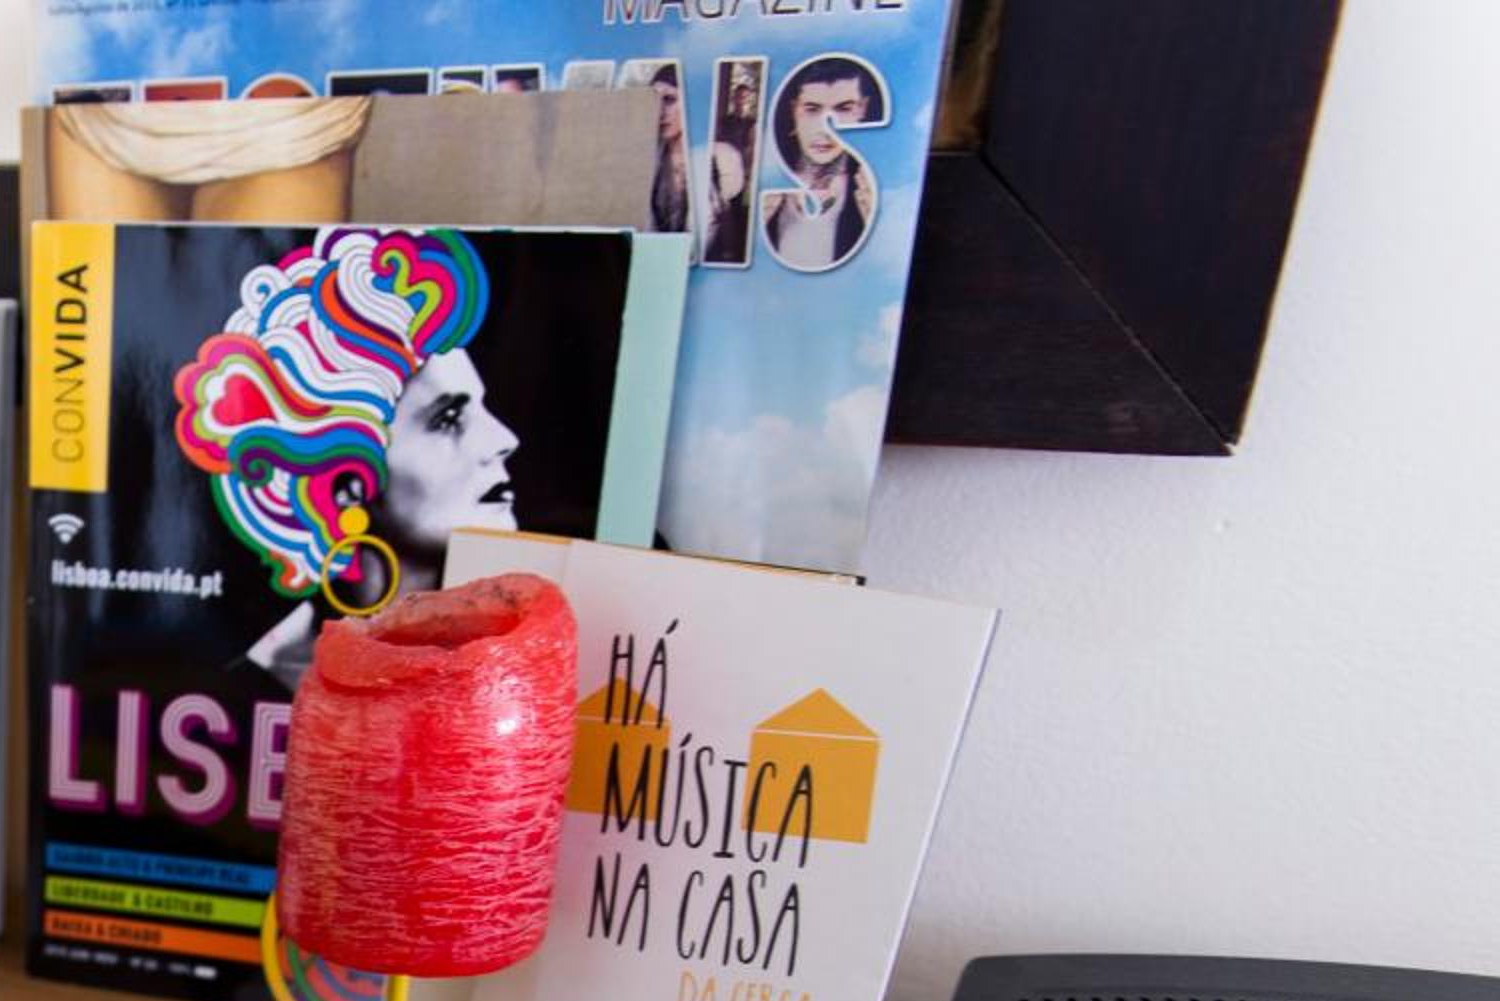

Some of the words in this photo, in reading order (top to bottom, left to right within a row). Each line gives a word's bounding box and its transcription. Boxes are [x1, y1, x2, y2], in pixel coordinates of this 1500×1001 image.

[49, 263, 90, 464] CONVIDA
[50, 559, 224, 598] lisboa.convida.pt
[604, 617, 679, 729] HÁ
[598, 732, 815, 869] MÚSICA
[586, 852, 653, 953] NA
[676, 869, 803, 978] CASA
